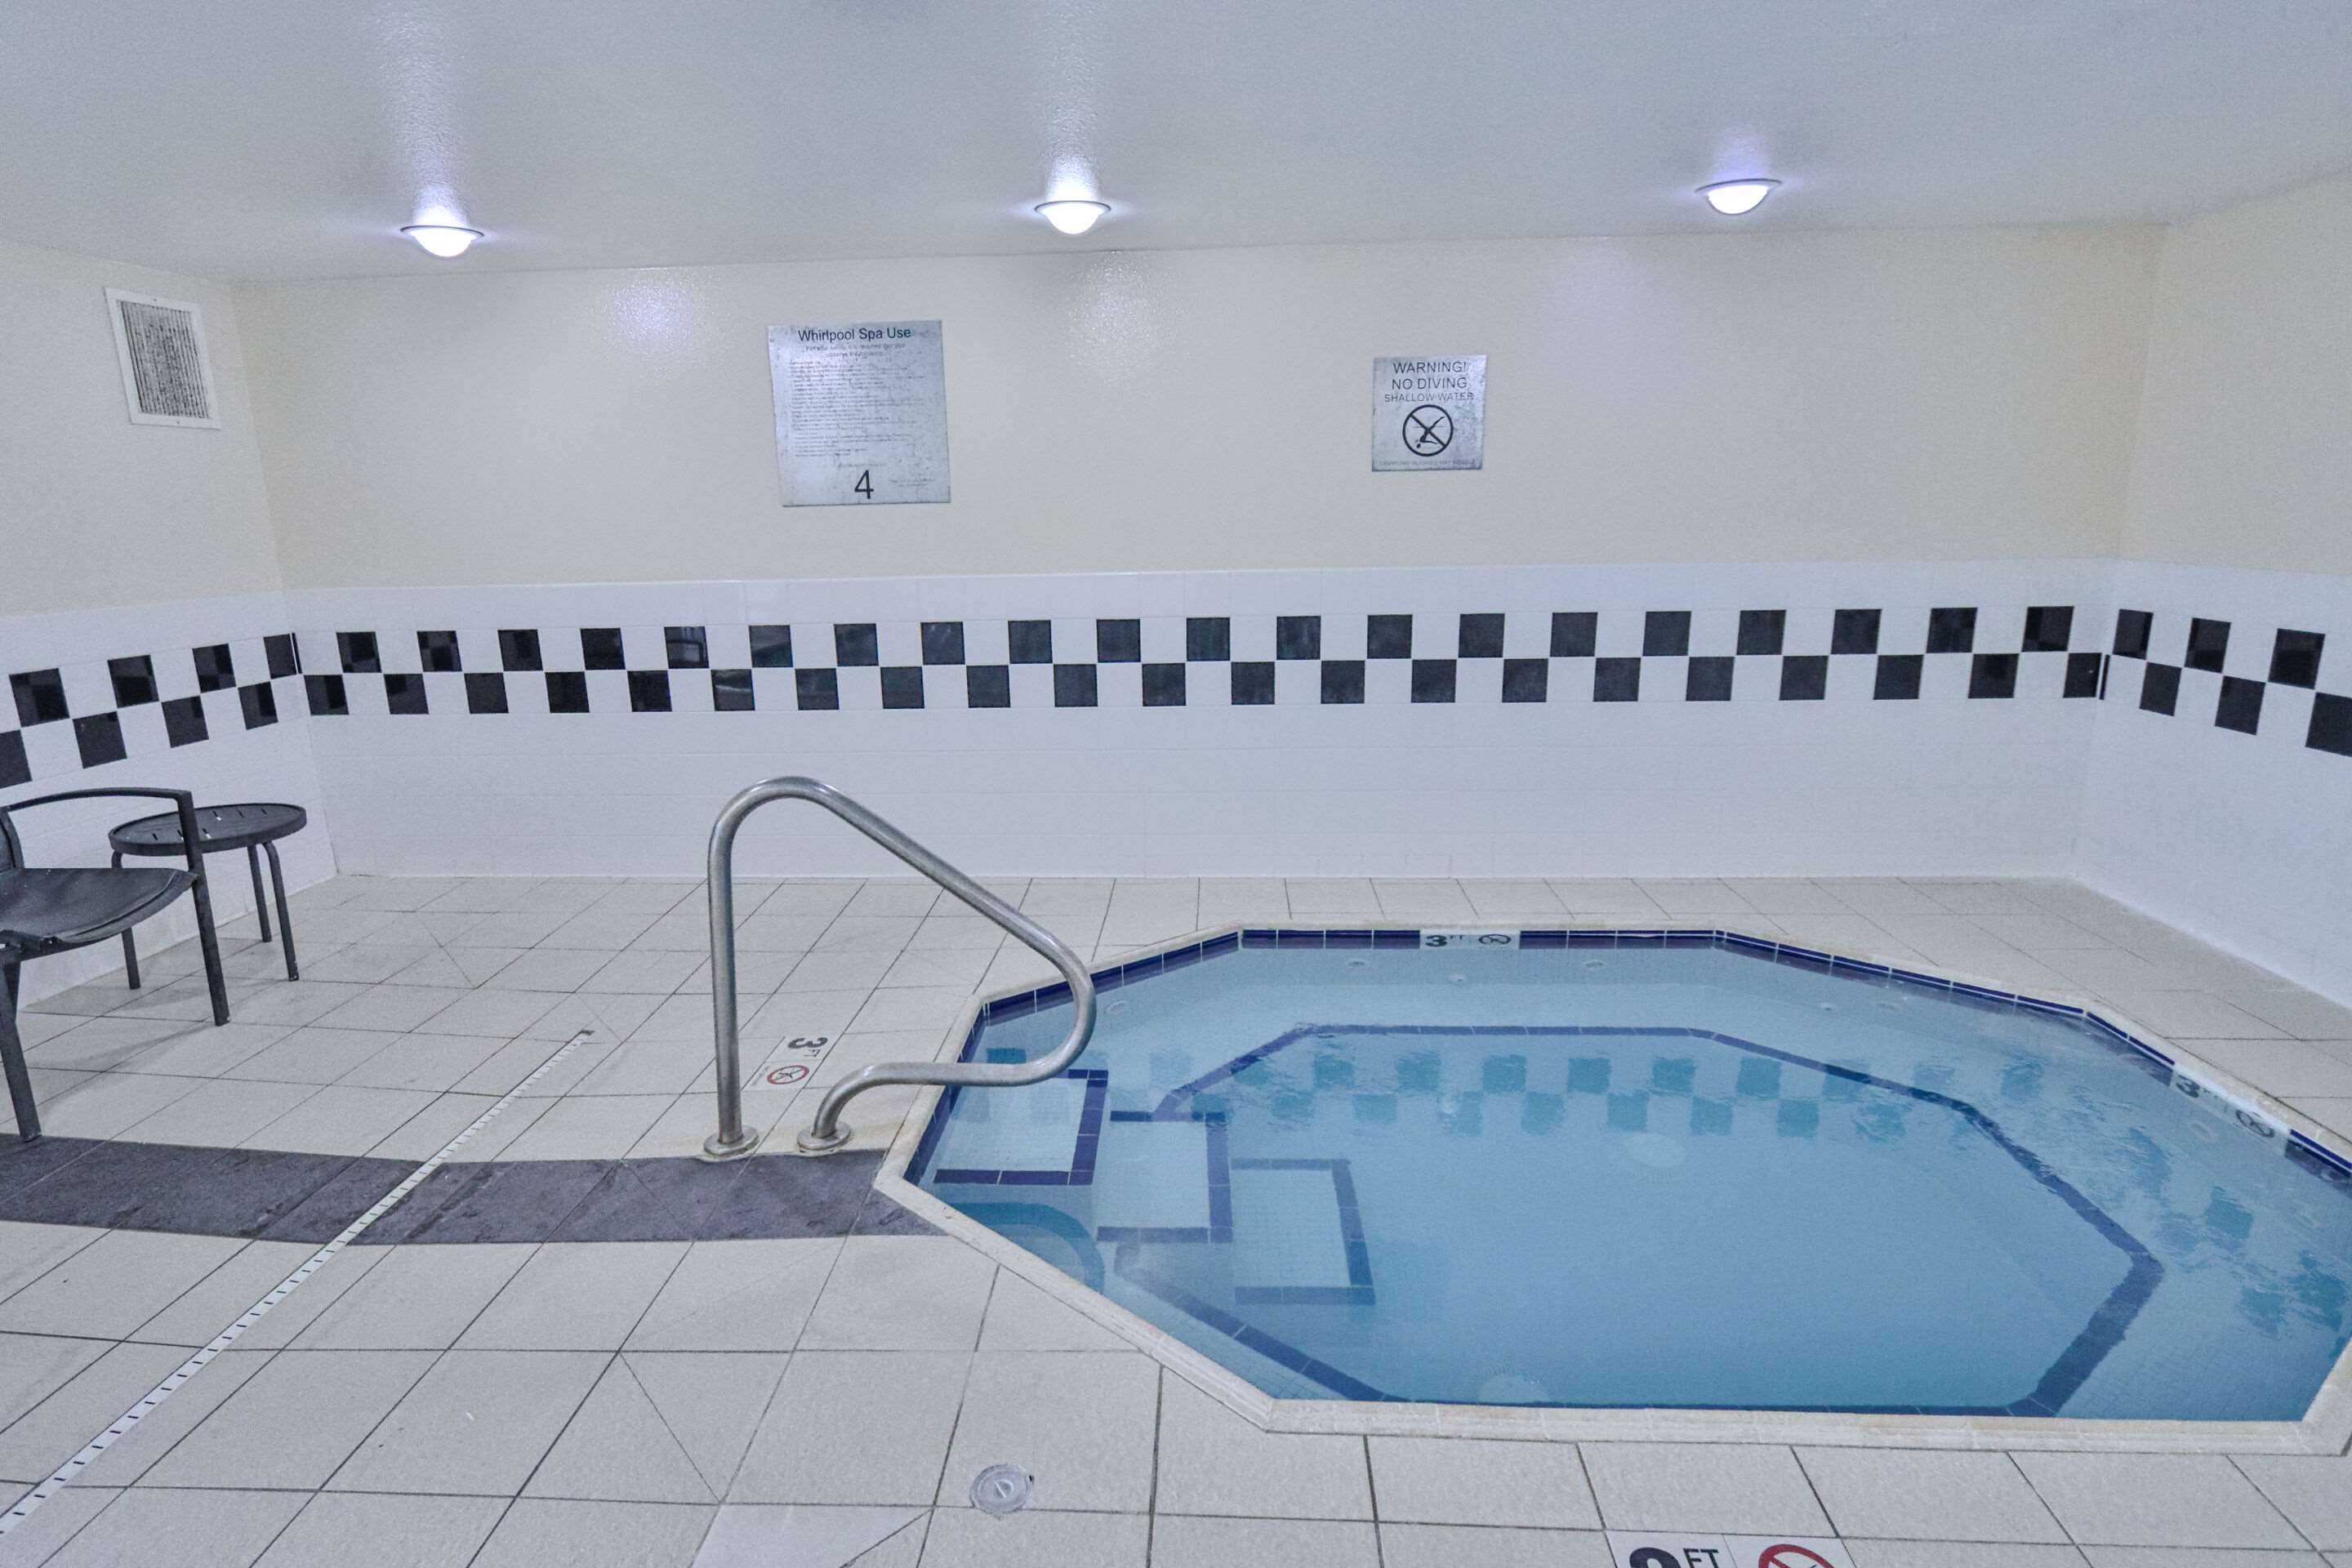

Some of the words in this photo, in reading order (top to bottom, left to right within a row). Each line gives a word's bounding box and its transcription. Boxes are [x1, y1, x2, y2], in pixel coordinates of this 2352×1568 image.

[798, 329, 855, 343] Whirlpool
[859, 327, 883, 341] Spa
[887, 327, 911, 339] Use
[1394, 361, 1466, 373] WARNING!
[1392, 379, 1413, 390] NO
[1418, 377, 1468, 390] DIVING
[1384, 394, 1435, 403] SHALLOW
[1438, 392, 1474, 401] WATER
[853, 470, 875, 499] 4
[1426, 934, 1447, 947] 3
[788, 1037, 828, 1049] 3
[2176, 1075, 2200, 1098] 3
[1682, 1548, 1719, 1568] FT
